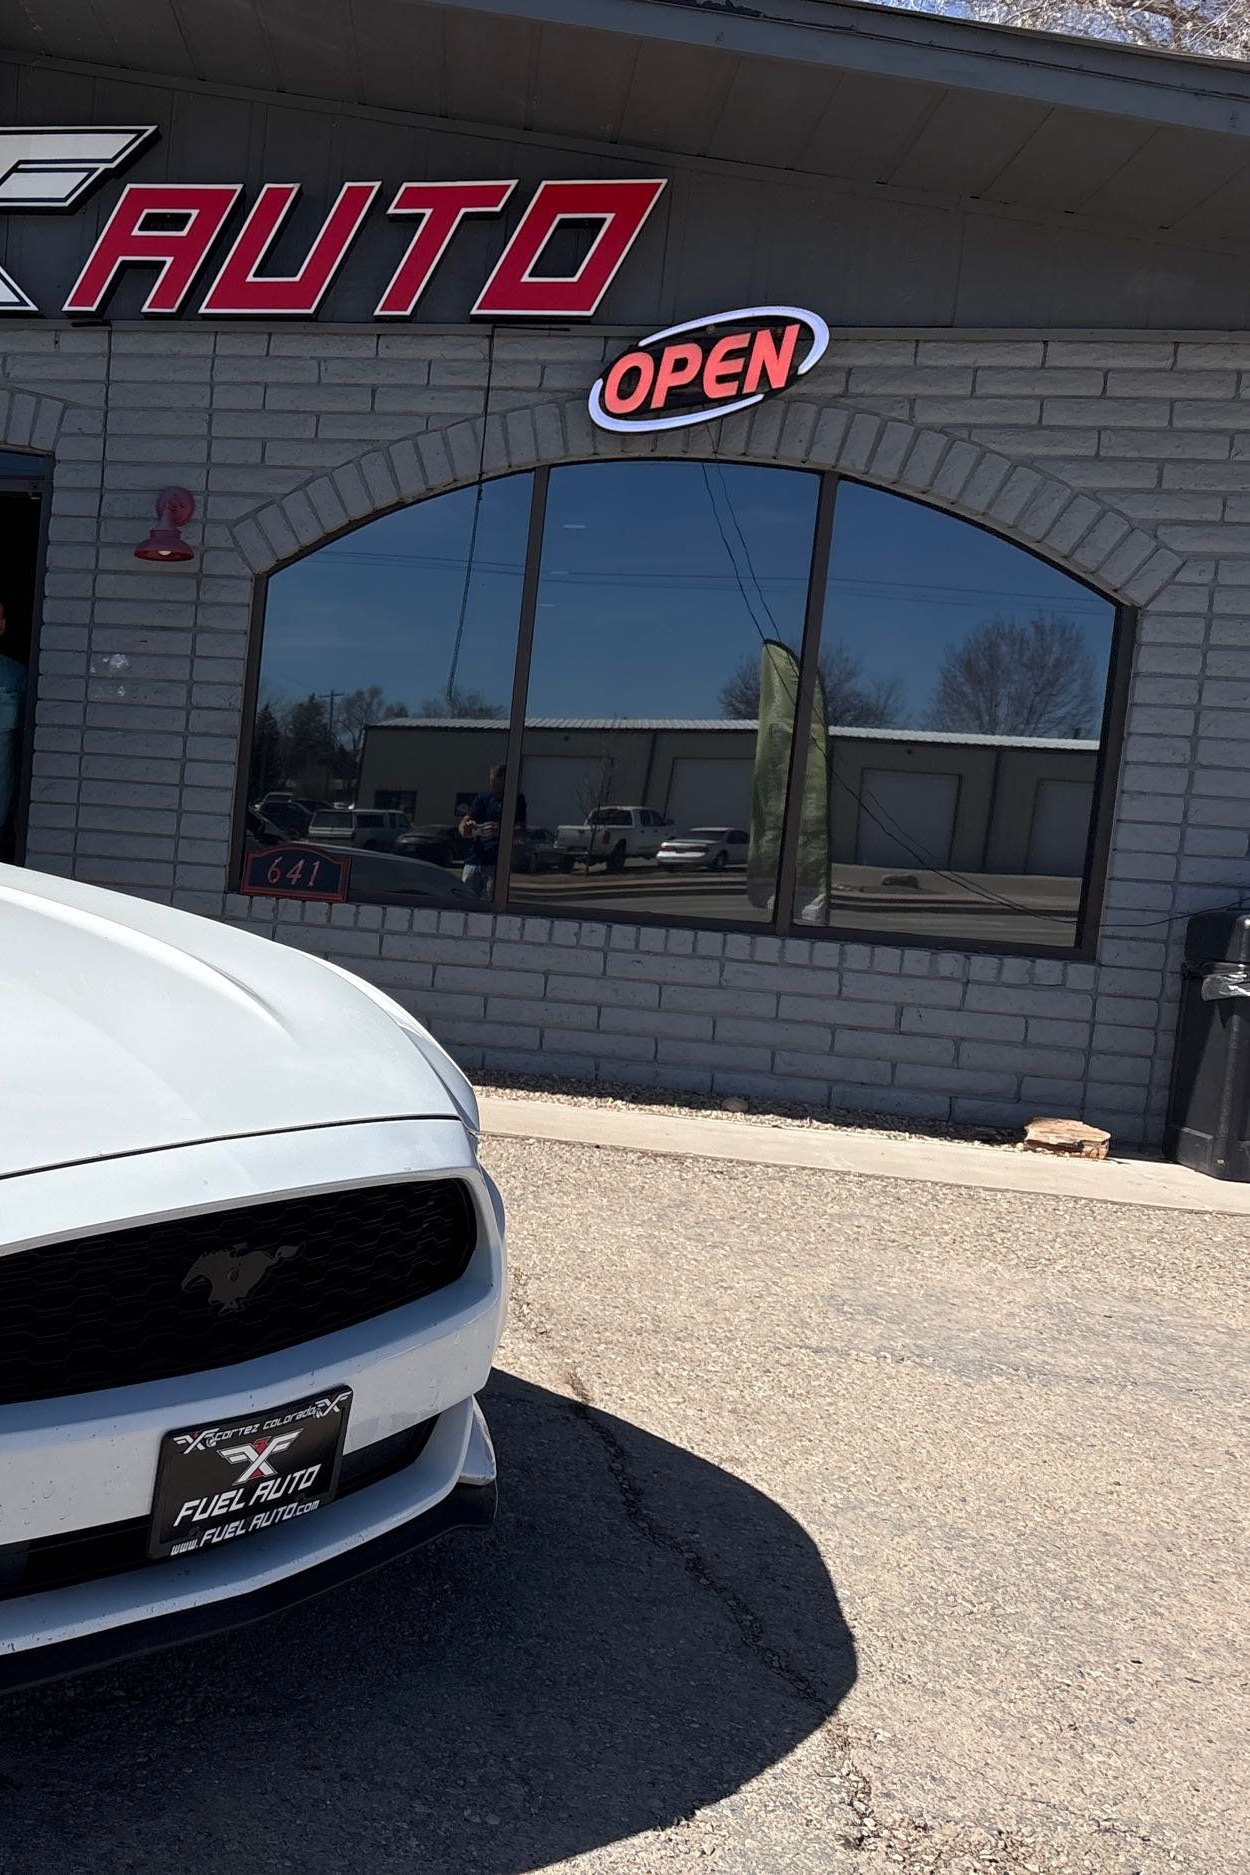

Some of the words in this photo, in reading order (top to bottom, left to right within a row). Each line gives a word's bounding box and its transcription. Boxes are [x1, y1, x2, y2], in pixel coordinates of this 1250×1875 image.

[62, 178, 668, 317] AUTO
[604, 323, 800, 415] OPEN
[267, 856, 321, 887] 641
[173, 1488, 245, 1527] FUEL
[249, 1464, 322, 1506] AUTO
